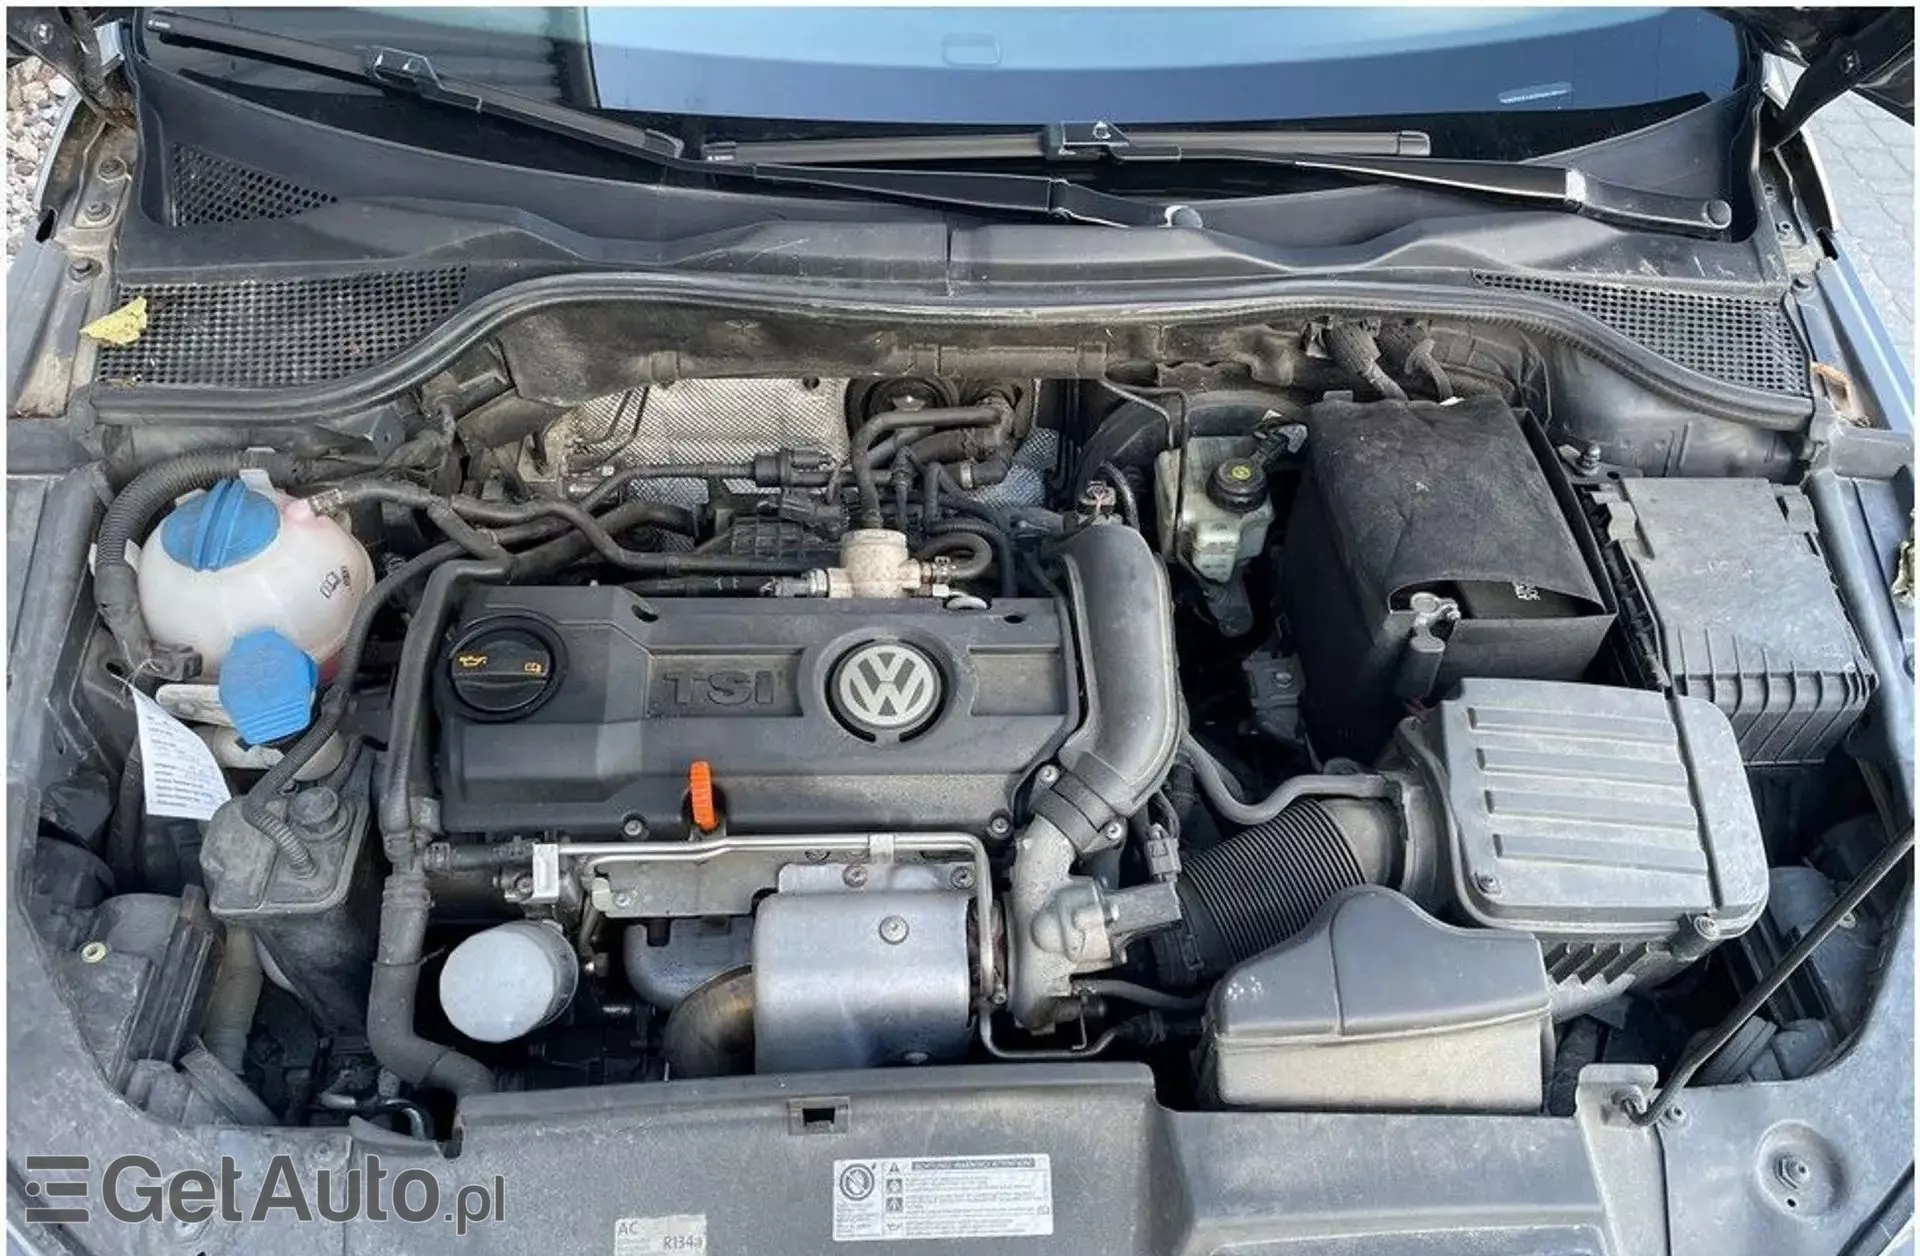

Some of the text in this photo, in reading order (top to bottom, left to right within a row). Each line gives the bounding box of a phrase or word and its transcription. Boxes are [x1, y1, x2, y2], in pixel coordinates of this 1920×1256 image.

[663, 671, 774, 704] TSI
[840, 645, 934, 725] VW
[619, 1221, 638, 1235] AC
